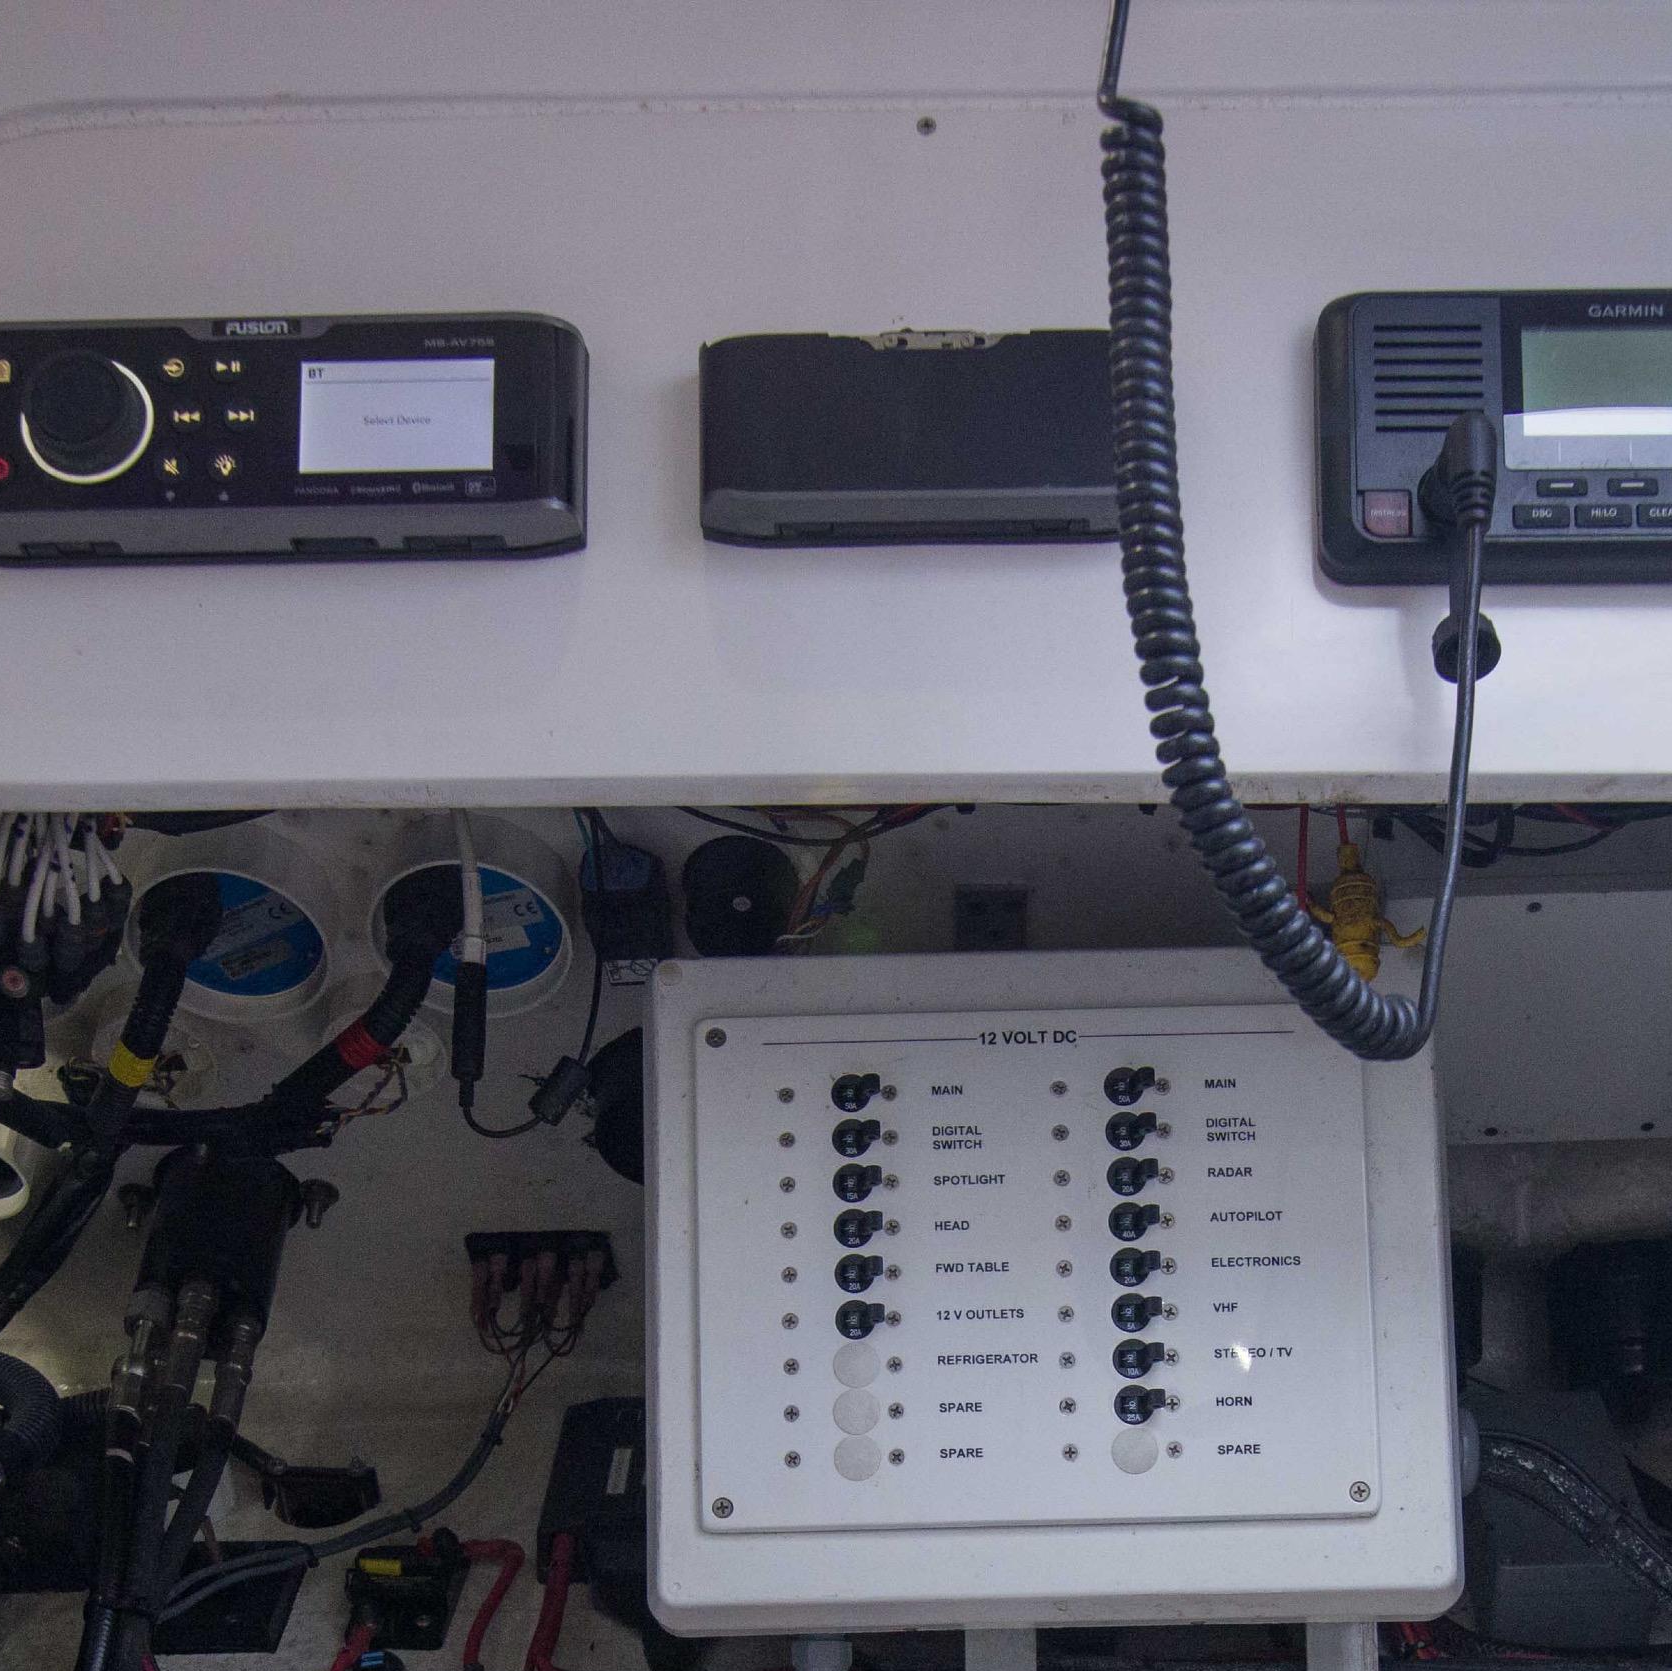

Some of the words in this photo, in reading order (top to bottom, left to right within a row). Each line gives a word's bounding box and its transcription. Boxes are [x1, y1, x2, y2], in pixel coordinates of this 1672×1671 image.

[1588, 304, 1664, 318] GARMIN
[226, 320, 289, 335] FUSION
[308, 367, 324, 379] BT
[363, 414, 394, 426] Select
[397, 414, 431, 425] Device
[979, 1032, 996, 1045] 12
[1002, 1031, 1047, 1044] VOLT
[1053, 1030, 1077, 1043] DC
[1204, 1079, 1236, 1089] MAIN
[932, 1085, 963, 1096] MAIN
[1206, 1117, 1256, 1128] DIGITAL
[932, 1126, 982, 1136] DIGITAL
[1206, 1131, 1256, 1142] SWITCH
[932, 1140, 982, 1150] SWITCH
[1208, 1167, 1252, 1177] RADAR
[933, 1175, 1005, 1186] SPOTLIGHT
[1210, 1211, 1283, 1222] AUTOPILOT
[935, 1221, 970, 1231] HEAD
[1211, 1256, 1301, 1267] ELECTRONICS
[935, 1263, 964, 1273] FWD
[968, 1262, 1009, 1273] TABLE
[849, 1282, 861, 1290] 20A
[1213, 1302, 1238, 1313] VHF
[936, 1310, 951, 1320] 12
[954, 1310, 963, 1320] V
[965, 1309, 1024, 1320] OUTLETS
[850, 1328, 862, 1336] 20A
[1214, 1348, 1266, 1358] STEEO
[1276, 1347, 1293, 1358] TV
[937, 1353, 1038, 1365] REFRIGERATOR
[1216, 1396, 1252, 1406] HORN
[939, 1402, 983, 1413] SPARE
[1127, 1413, 1140, 1421] 25A
[939, 1448, 984, 1459] SPARE
[1217, 1444, 1261, 1455] SPARE
